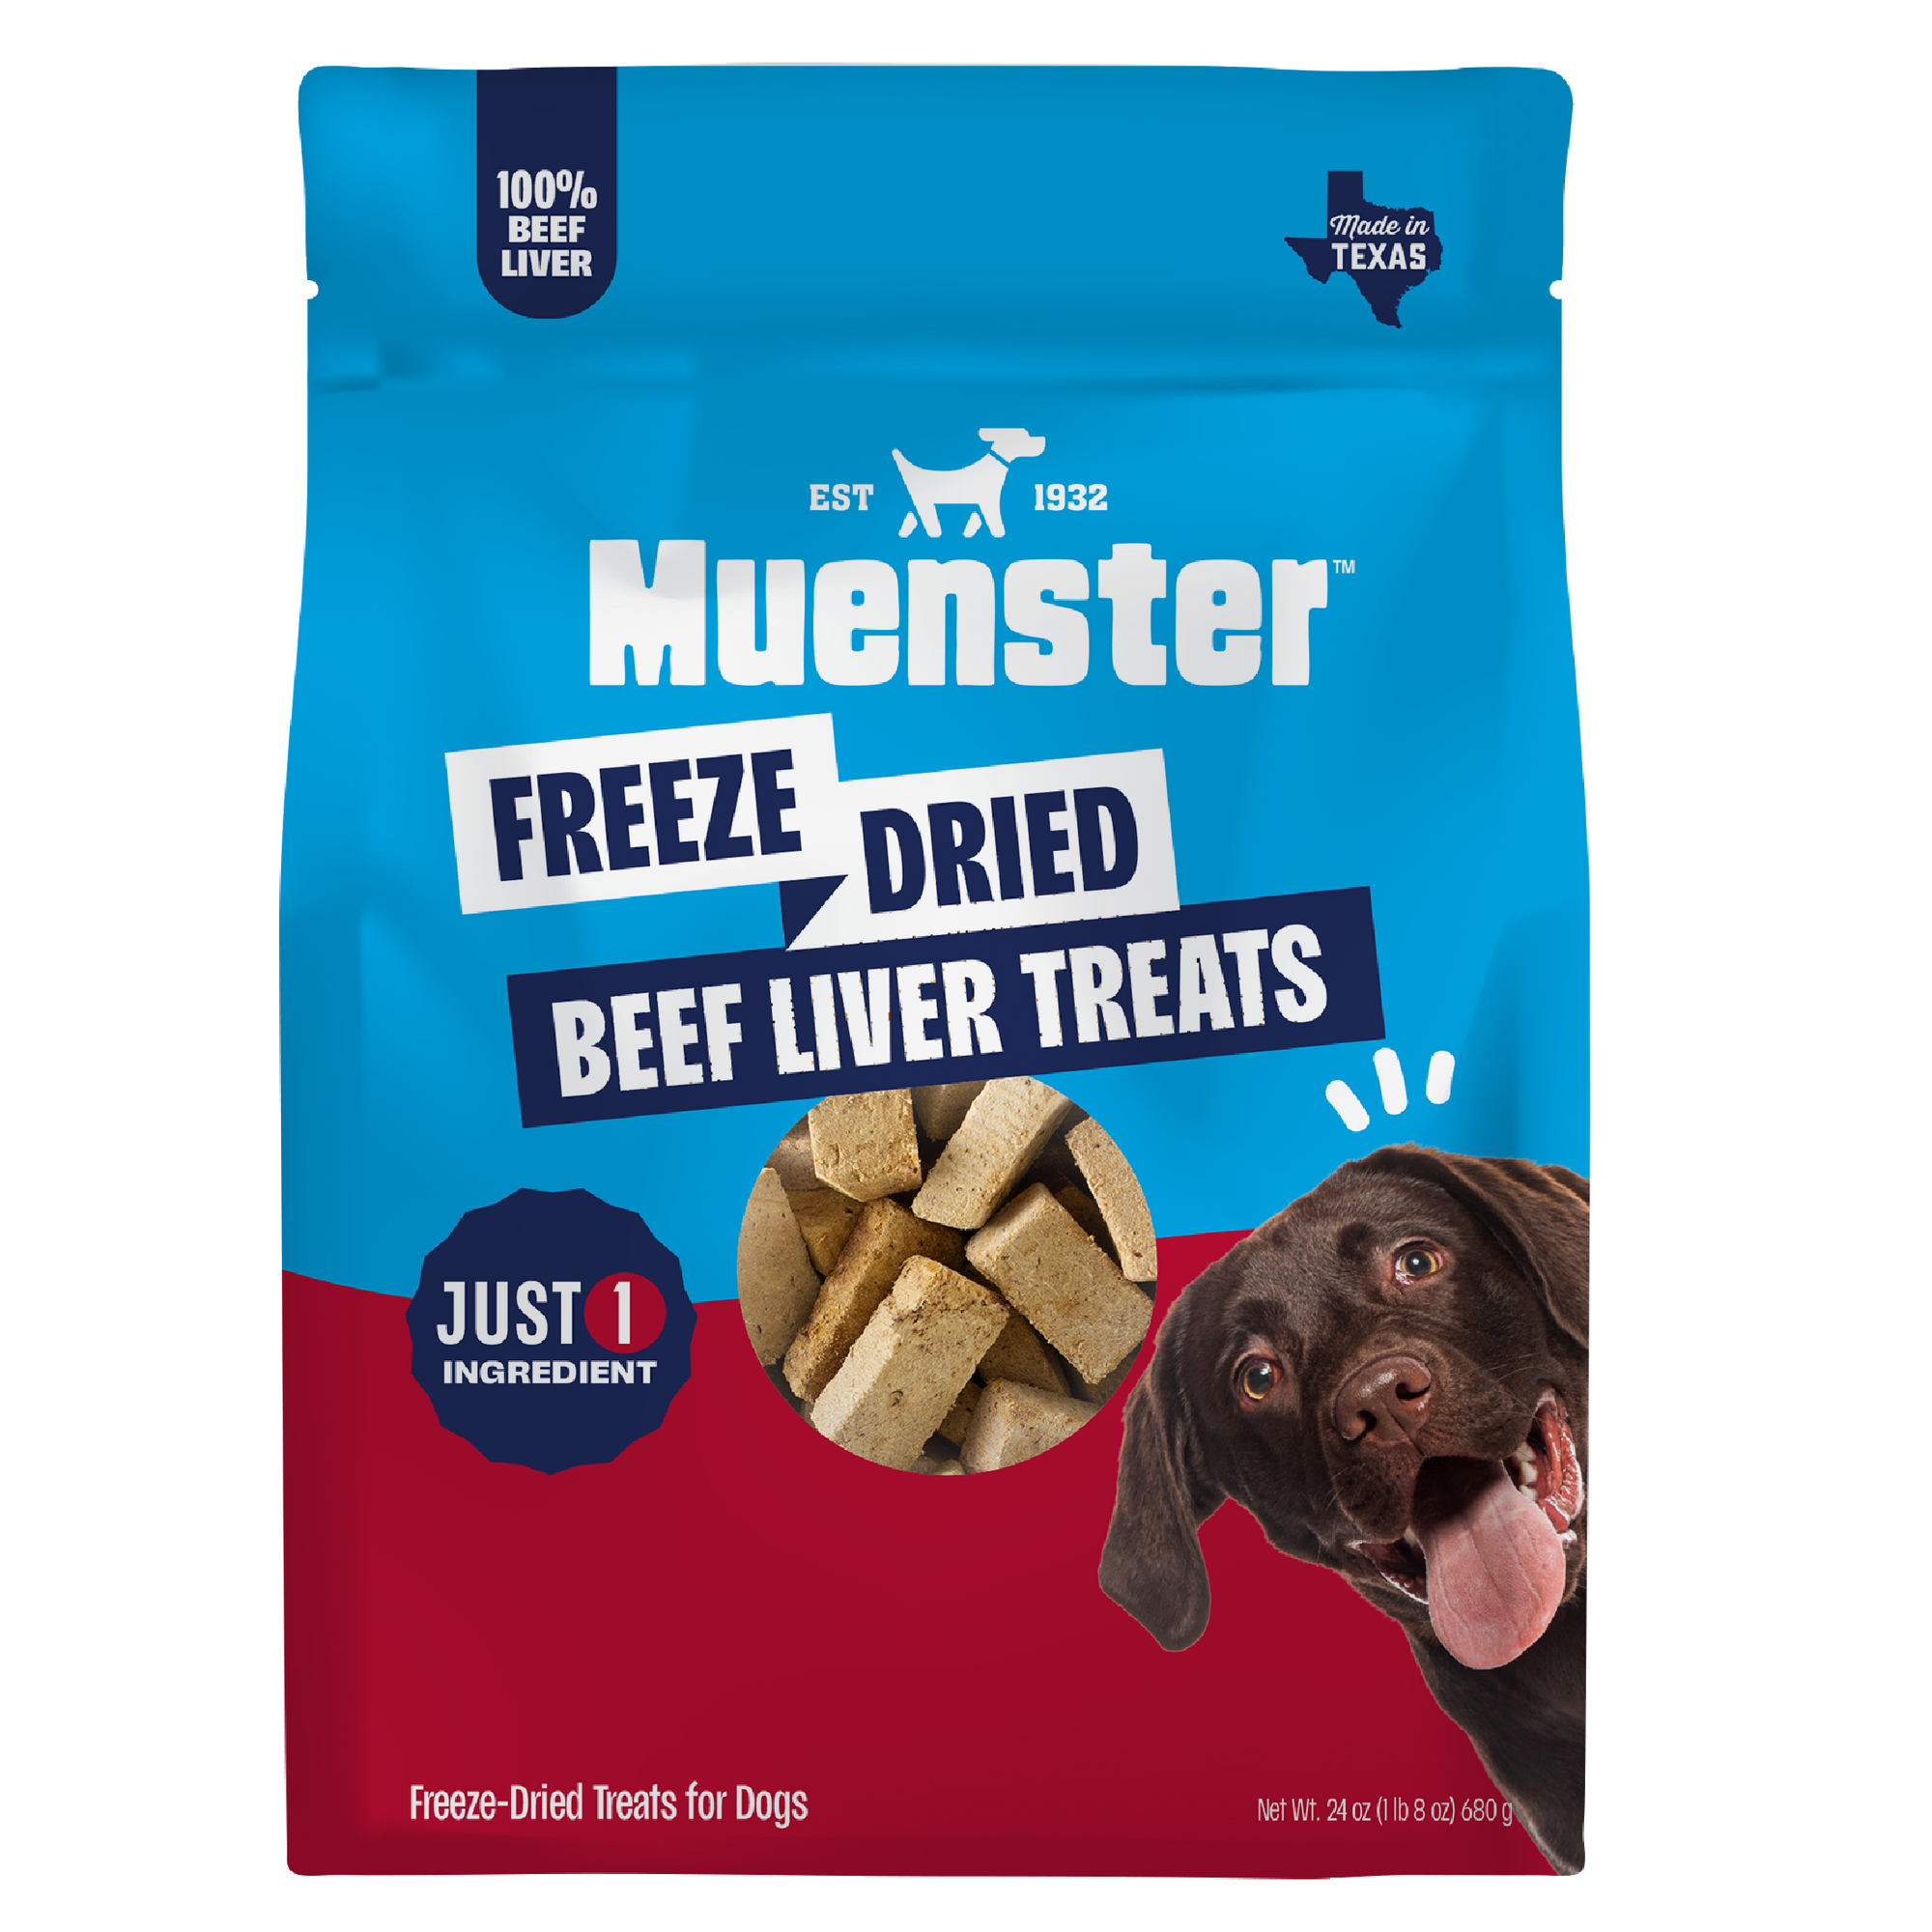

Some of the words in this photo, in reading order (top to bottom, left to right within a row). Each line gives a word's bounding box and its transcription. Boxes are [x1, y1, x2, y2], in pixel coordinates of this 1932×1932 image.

[496, 168, 598, 210] 100%
[508, 215, 586, 243] BEEF
[1329, 214, 1402, 241] Made
[1405, 214, 1431, 236] in
[501, 249, 593, 277] LIVER
[1331, 242, 1427, 270] TEXAS
[810, 483, 874, 512] EST
[1035, 483, 1108, 512] 1932
[589, 539, 1328, 687] Muenster
[489, 749, 802, 882] FREEZE
[860, 786, 1139, 915] DRIED
[552, 982, 743, 1097] BEEF
[769, 959, 1003, 1075] LIVER
[1019, 923, 1328, 1048] TREATS
[437, 1280, 582, 1346] JUST
[612, 1281, 631, 1345] 1
[443, 1359, 658, 1384] INGREDIENT
[411, 1781, 583, 1821] Freeze-Dried
[592, 1783, 677, 1821] Treats
[684, 1780, 727, 1821] for
[736, 1785, 809, 1830] Dogs
[1258, 1798, 1288, 1822] Net
[1292, 1798, 1320, 1822] Wt.
[1326, 1798, 1348, 1822] 24
[1351, 1802, 1372, 1822] oz
[1376, 1796, 1387, 1825] (1
[1393, 1797, 1409, 1822] lb
[1413, 1798, 1426, 1822] 8
[1431, 1796, 1456, 1825] oz)
[1462, 1798, 1497, 1822] 680
[1501, 1801, 1514, 1827] g
